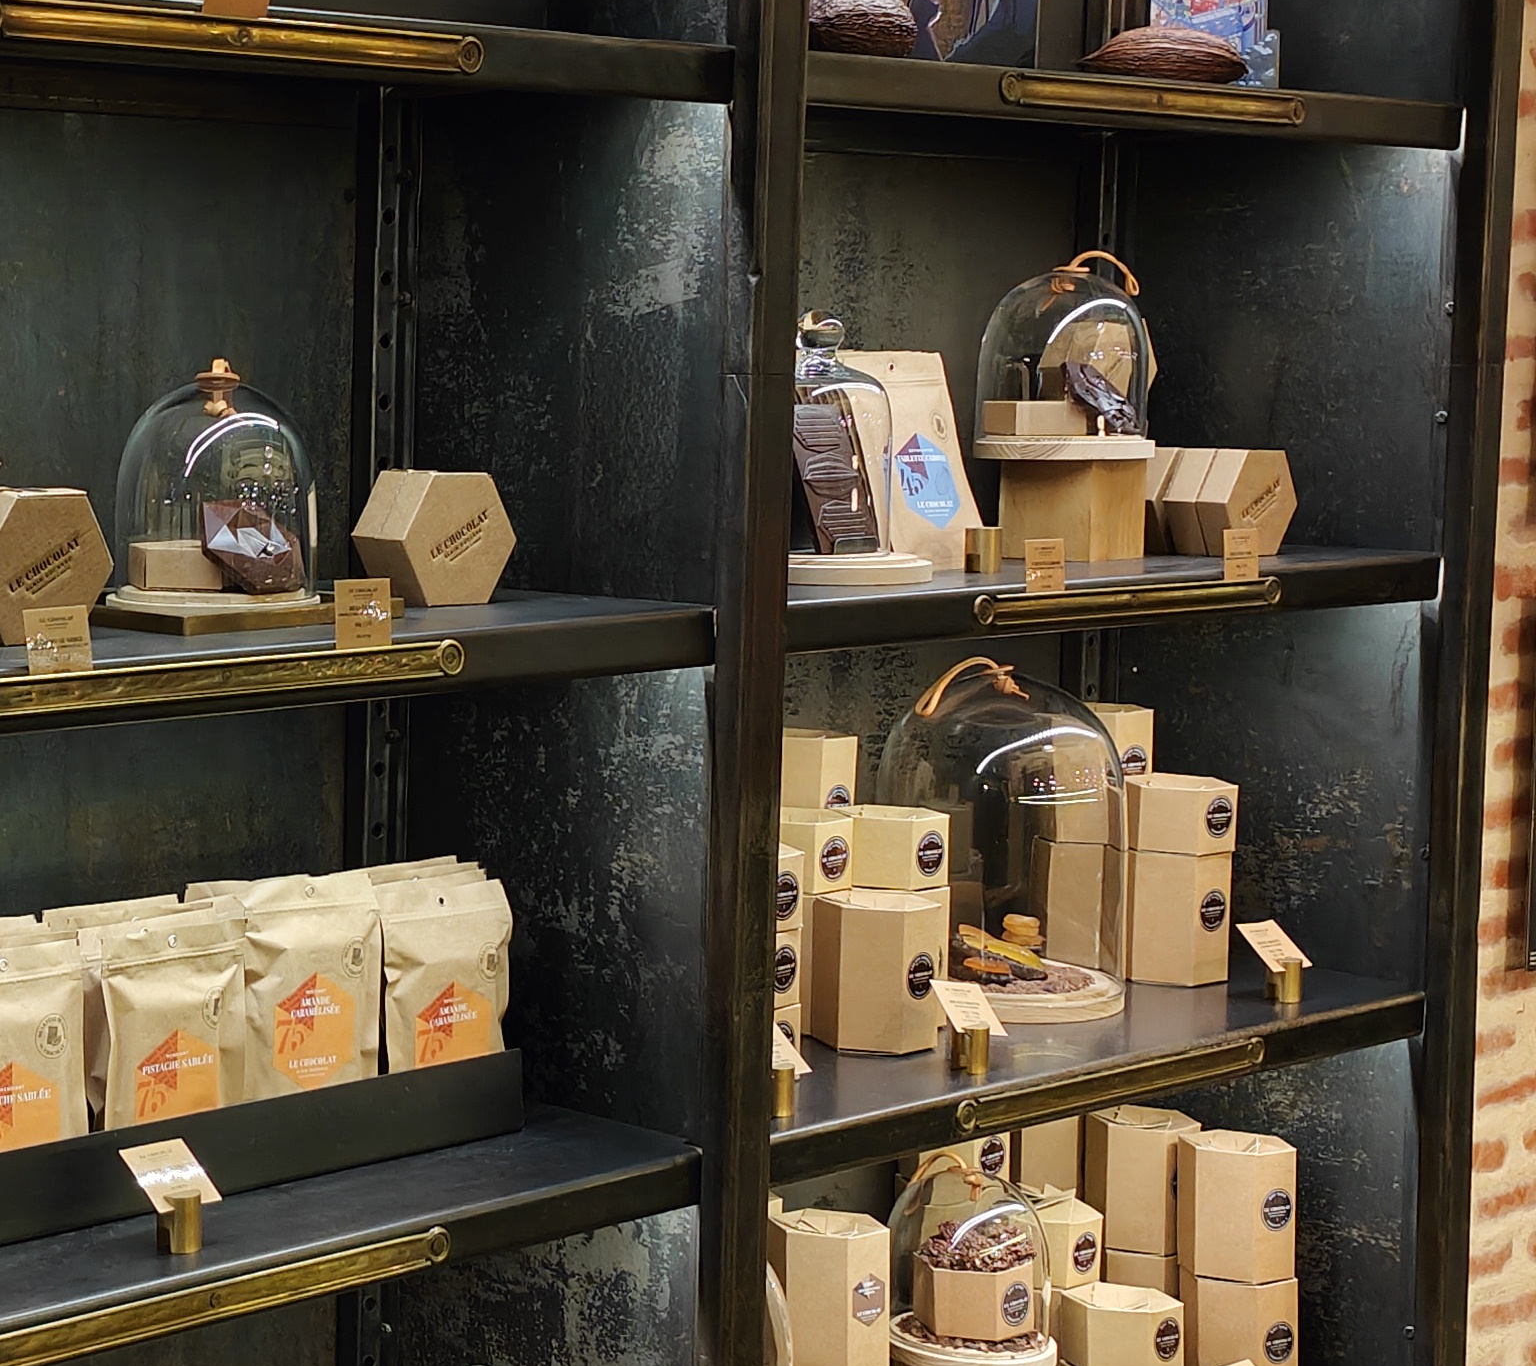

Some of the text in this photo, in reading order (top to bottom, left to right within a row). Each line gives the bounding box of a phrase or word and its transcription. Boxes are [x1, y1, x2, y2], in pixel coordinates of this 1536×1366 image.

[429, 509, 489, 561] LE CHOCOLAT
[7, 535, 81, 595] LE CHOCOLAT
[300, 995, 330, 1008] AMANDE
[438, 1003, 468, 1016] AMANDE
[290, 1003, 341, 1019] CARAMÉLISÉE
[430, 1010, 478, 1028] CARAMÉLISÉE
[142, 1053, 214, 1076] PISTACHE SABLÉE
[289, 1055, 337, 1069] LE CHOCOLAT
[17, 1087, 51, 1103] SABLÉE
